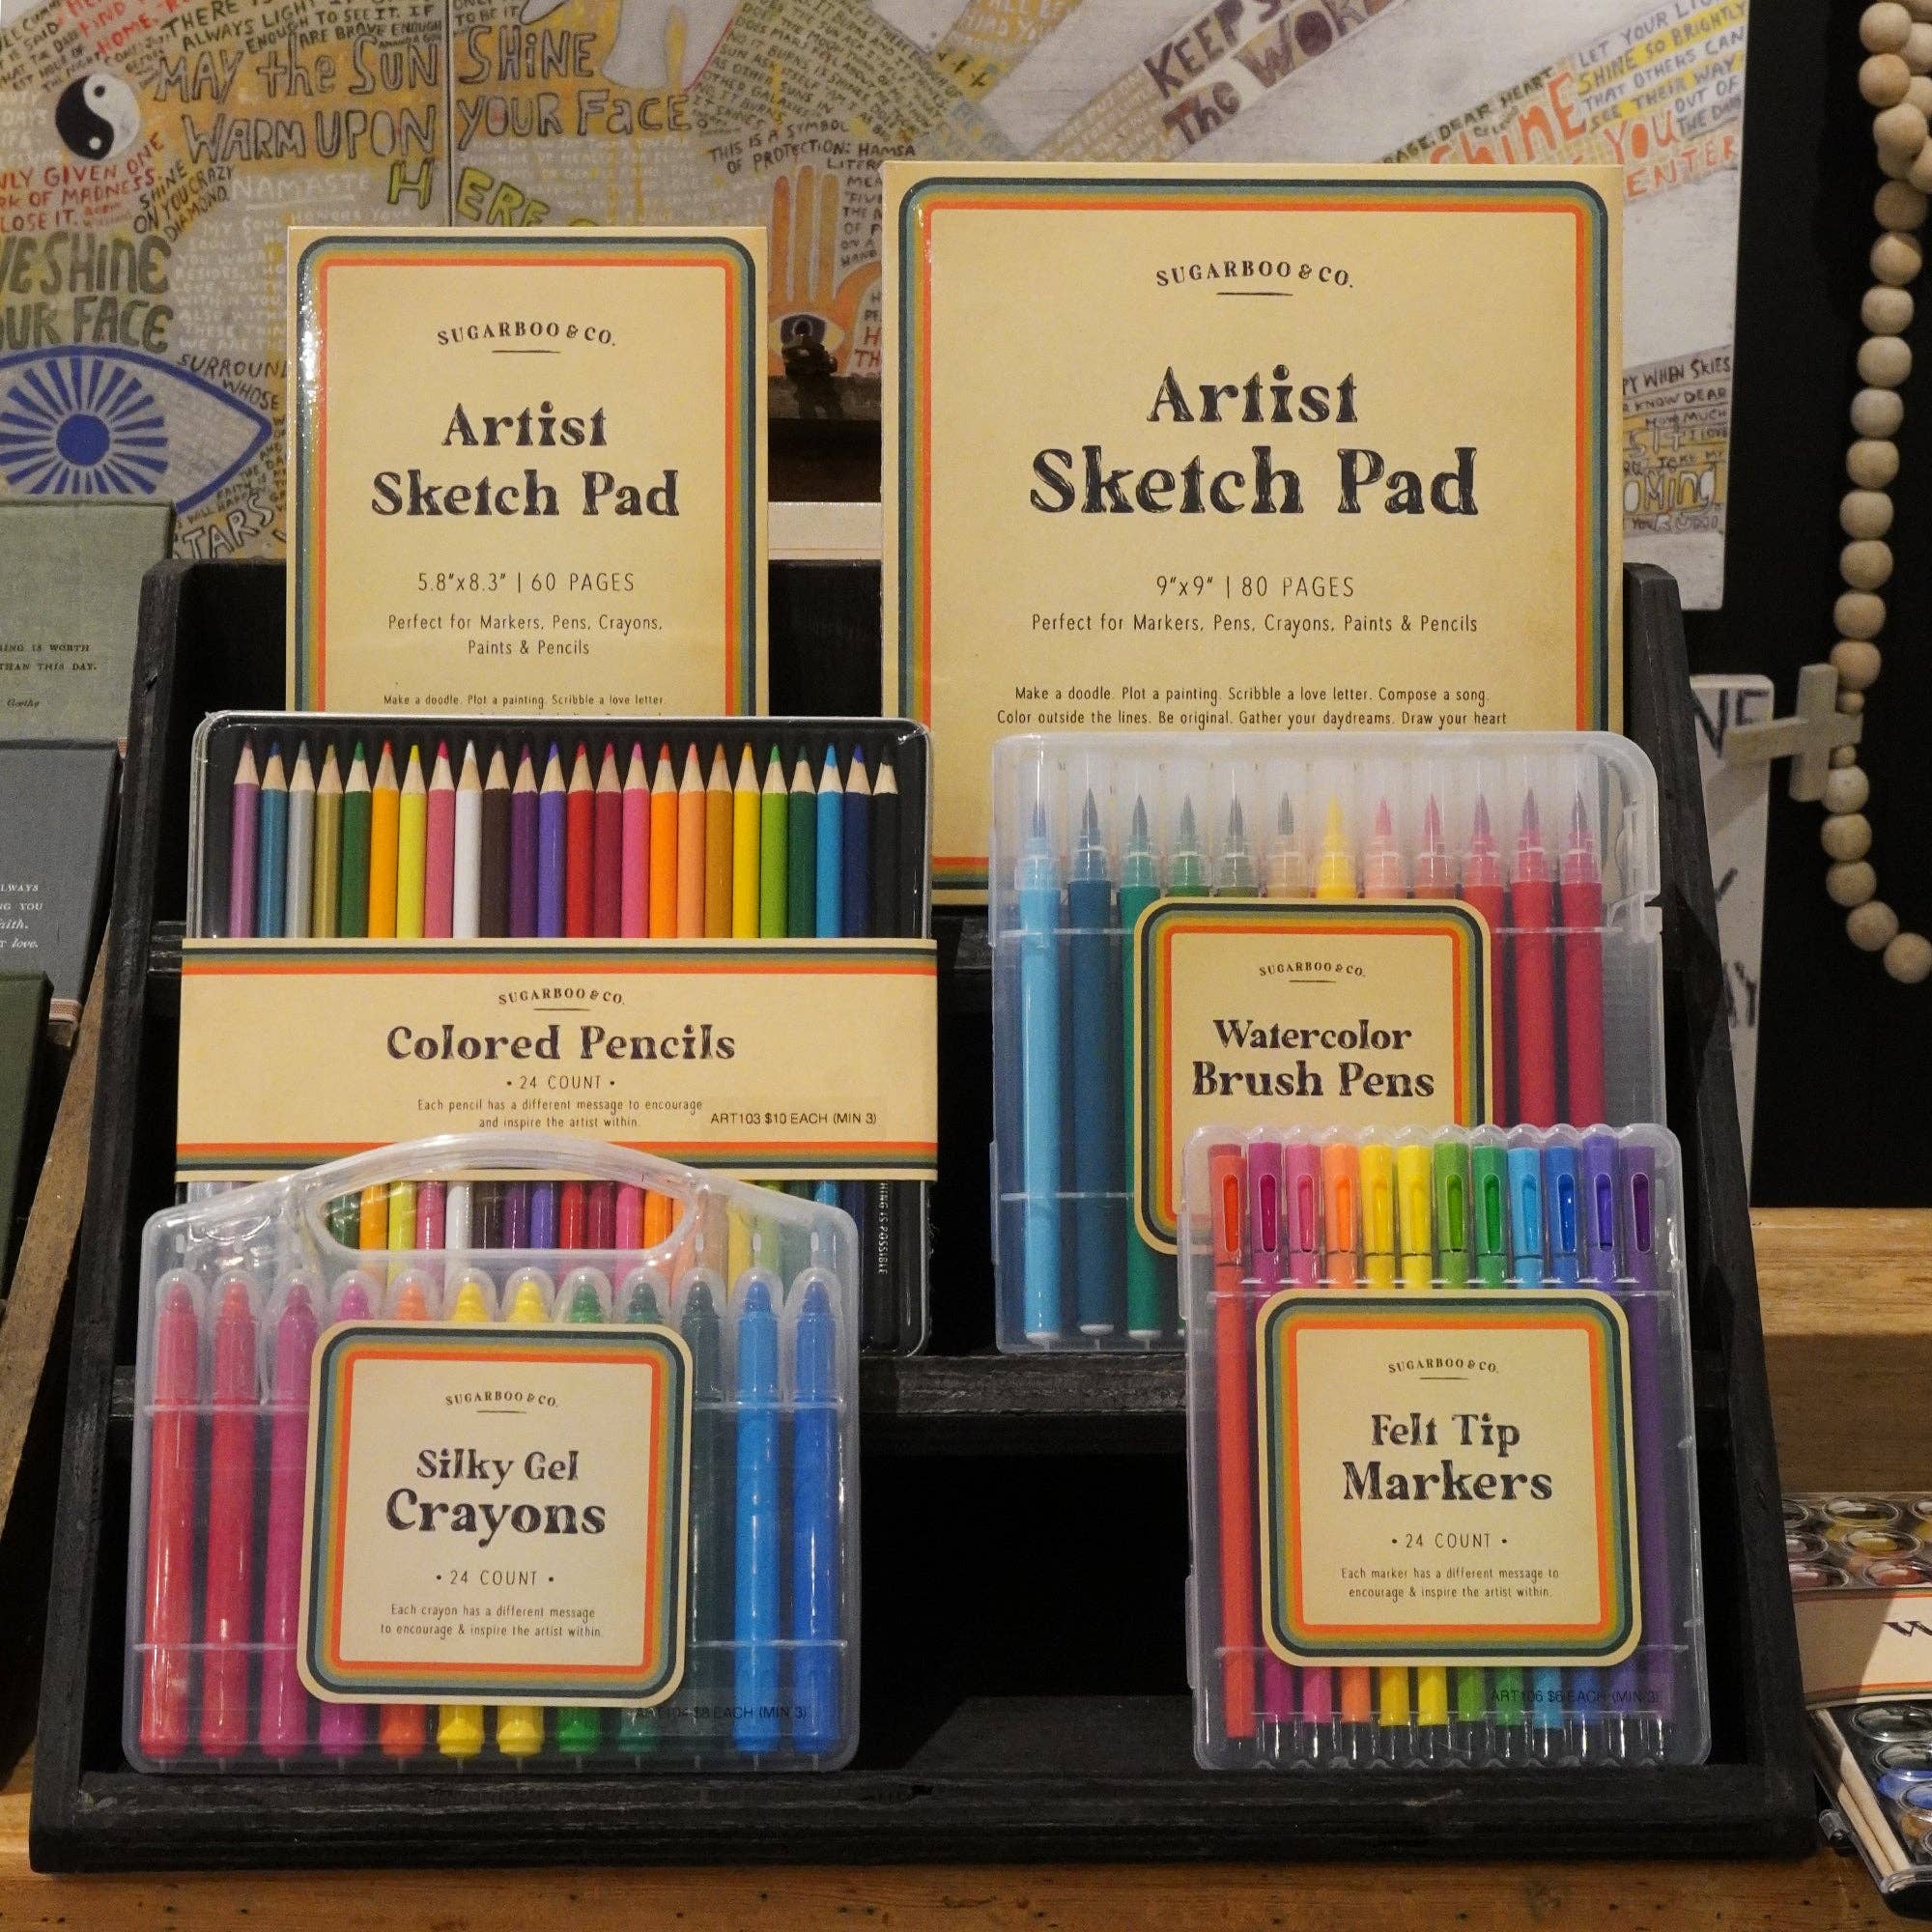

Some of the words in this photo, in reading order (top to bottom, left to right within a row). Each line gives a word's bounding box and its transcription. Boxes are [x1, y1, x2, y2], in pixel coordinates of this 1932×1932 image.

[1144, 0, 1243, 99] KEEP
[155, 48, 242, 103] MAY
[349, 33, 438, 95] SUN
[182, 112, 305, 162] WARM
[316, 104, 436, 159] UPON
[711, 142, 743, 161] THIS
[749, 133, 761, 147] IS
[768, 129, 779, 143] A
[786, 119, 850, 138] SYMBOL
[1156, 261, 1291, 286] SUGARBOO
[1298, 264, 1312, 279] &
[1319, 267, 1353, 289] CO.
[438, 322, 559, 345] SUGARBOO
[566, 325, 579, 338] &
[584, 327, 615, 346] CO.
[1147, 364, 1357, 423] Artist
[441, 401, 607, 446] Artist
[1031, 445, 1304, 514] Sketch
[1337, 447, 1478, 515] Pad
[372, 469, 559, 516] Sketch
[582, 469, 679, 516] Pad
[531, 573, 555, 591] 60
[570, 573, 634, 591] PAGES
[1242, 576, 1267, 596] 80
[1283, 577, 1353, 597] PAGES
[389, 613, 441, 629] Perfect
[450, 613, 470, 630] for
[480, 614, 543, 630] Markers,
[554, 614, 590, 630] Pens,
[599, 614, 662, 636] Crayons,
[1033, 612, 1091, 631] Perfect
[1100, 613, 1122, 631] for
[1134, 614, 1203, 631] Markers,
[1214, 614, 1255, 631] Pens,
[1264, 613, 1334, 639] Crayons,
[1345, 614, 1392, 632] Paints
[1401, 615, 1410, 631] &
[1421, 614, 1477, 632] Pencils
[469, 640, 512, 655] Paints
[520, 639, 528, 654] &
[538, 639, 589, 655] Pencils
[1015, 687, 1048, 699] Make
[1056, 690, 1062, 699] a
[1068, 686, 1114, 699] doodle.
[1122, 687, 1146, 699] Plot
[1152, 691, 1159, 699] a
[1166, 688, 1222, 706] painting.
[1229, 686, 1281, 700] Scribble
[1288, 691, 1293, 700] a
[1301, 687, 1326, 700] love
[1333, 687, 1372, 700] letter.
[1378, 687, 1436, 704] Compose
[1443, 691, 1449, 700] a
[1457, 691, 1490, 707] song.
[997, 710, 1031, 724] Color
[1038, 710, 1084, 724] outside
[1092, 711, 1112, 724] the
[1119, 710, 1151, 724] lines.
[1159, 711, 1174, 724] Be
[1180, 710, 1233, 730] original.
[1239, 711, 1281, 724] Gather
[1288, 715, 1315, 730] your
[1323, 711, 1395, 730] daydreams.
[1402, 711, 1433, 724] Draw
[1438, 715, 1466, 730] your
[1474, 712, 1506, 724] heart
[1260, 962, 1331, 976] SUGARBOO
[1335, 963, 1343, 973] &
[1346, 965, 1366, 977] CO.
[498, 988, 585, 1005] SUGARBOO
[589, 990, 599, 1000] &
[603, 992, 625, 1005] CO.
[387, 1024, 560, 1060] Colored
[581, 1024, 734, 1060] Pencils
[1213, 1019, 1411, 1049] Watercolor
[520, 1075, 536, 1090] 24
[548, 1075, 600, 1090] COUNT
[1193, 1060, 1323, 1096] Brush
[1339, 1063, 1434, 1097] Pens
[418, 1099, 443, 1111] Each
[449, 1098, 482, 1113] pencil
[488, 1099, 505, 1110] has
[523, 1098, 570, 1110] different
[577, 1101, 623, 1116] message
[629, 1100, 639, 1110] to
[645, 1100, 702, 1116] encourage
[711, 1113, 760, 1124] ART103
[765, 1112, 786, 1124] $10
[790, 1113, 827, 1124] EACH
[834, 1113, 861, 1123] (MIN
[866, 1113, 876, 1124] 3)
[479, 1117, 498, 1127] and
[504, 1119, 541, 1130] inspire
[547, 1117, 564, 1127] the
[570, 1118, 598, 1127] artist
[1388, 1358, 1463, 1373] SUGARBOO
[1467, 1360, 1475, 1369] &
[1479, 1361, 1499, 1373] CO.
[445, 1391, 523, 1406] SUGARBOO
[526, 1393, 535, 1403] &
[538, 1395, 558, 1407] CO.
[1372, 1412, 1437, 1445] Felt
[1452, 1413, 1520, 1458] Tip
[417, 1448, 514, 1490] Silky
[525, 1450, 579, 1481] Gel
[1343, 1460, 1551, 1500] Markers
[386, 1488, 605, 1548] Crayons
[1406, 1533, 1423, 1548] 24
[1435, 1533, 1490, 1548] COUNT
[450, 1570, 468, 1584] 24
[480, 1570, 536, 1585] COUNT
[391, 1604, 416, 1614] Each
[421, 1606, 458, 1621] crayon
[464, 1605, 480, 1616] has
[497, 1605, 544, 1617] different
[550, 1608, 595, 1624] message
[381, 1624, 391, 1634] to
[396, 1626, 452, 1640] encourage
[458, 1624, 465, 1634] &
[470, 1627, 506, 1638] inspire
[513, 1626, 529, 1635] the
[535, 1627, 562, 1636] artist
